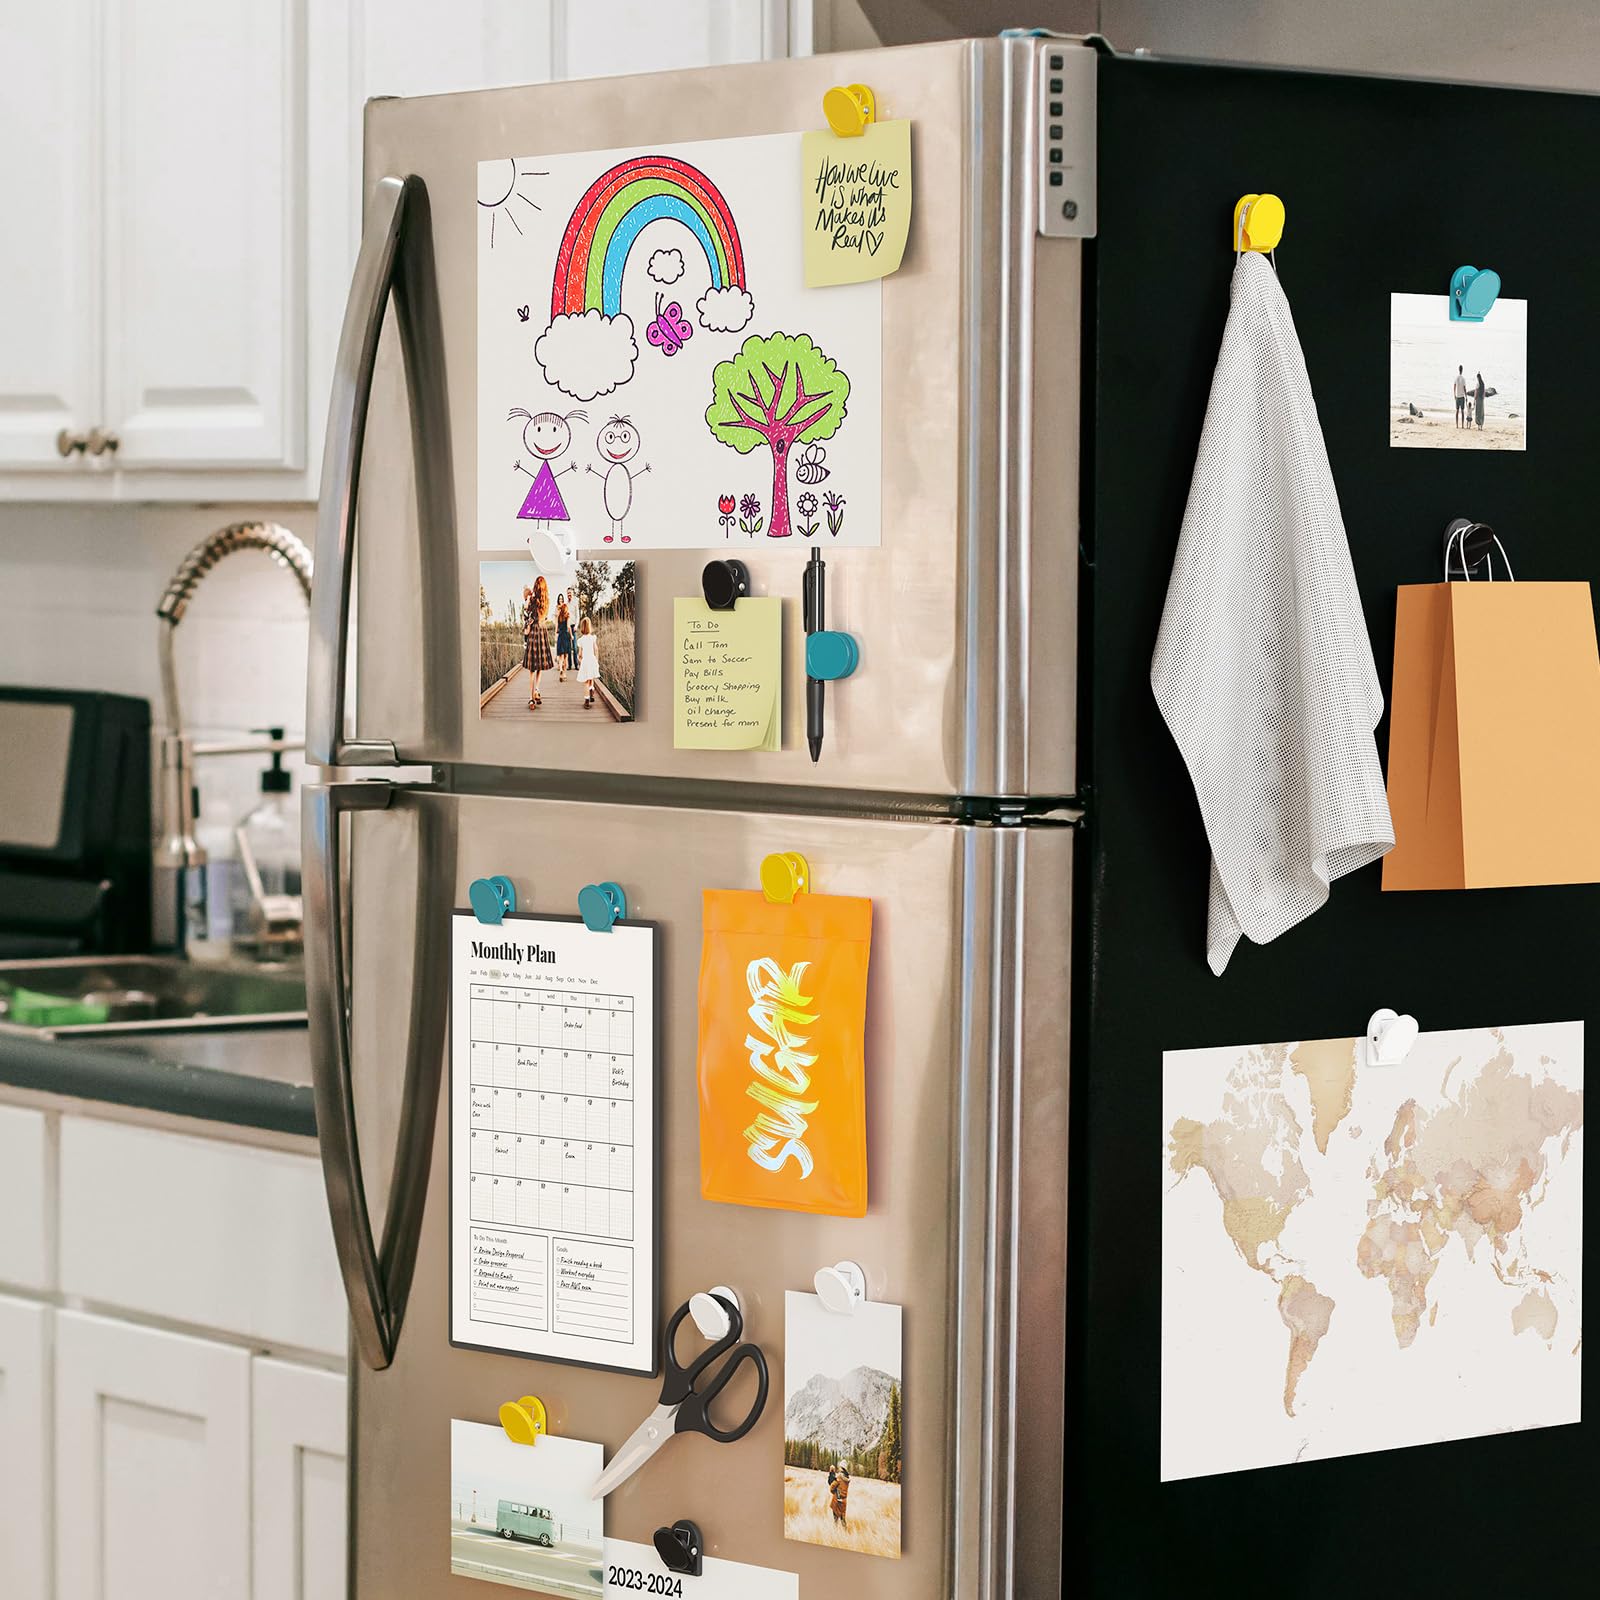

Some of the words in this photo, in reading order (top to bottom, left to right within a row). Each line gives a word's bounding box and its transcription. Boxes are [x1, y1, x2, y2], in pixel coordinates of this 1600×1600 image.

[815, 155, 845, 204] How
[847, 163, 867, 183] we
[869, 160, 899, 188] live
[831, 185, 845, 209] is
[851, 186, 888, 211] what
[815, 209, 865, 232] Makes
[832, 225, 865, 253] Real
[687, 621, 701, 629] To
[707, 621, 719, 629] Do
[684, 638, 703, 650] Call
[707, 641, 728, 649] Tom
[683, 654, 702, 664] Sam
[708, 655, 716, 664] to
[722, 654, 752, 664] Soccer
[684, 669, 699, 679] Pay
[703, 669, 723, 677] Bills
[686, 681, 719, 693] Grocery
[722, 682, 761, 693] Shopping
[685, 695, 700, 704] Buy
[705, 695, 728, 703] milk
[704, 708, 736, 717] change
[687, 719, 718, 728] Present
[722, 718, 735, 727] for
[471, 941, 524, 965] Monthly
[527, 944, 556, 964] Plan
[743, 957, 820, 1180] SUGAR
[608, 1565, 683, 1599] 2023-2024
